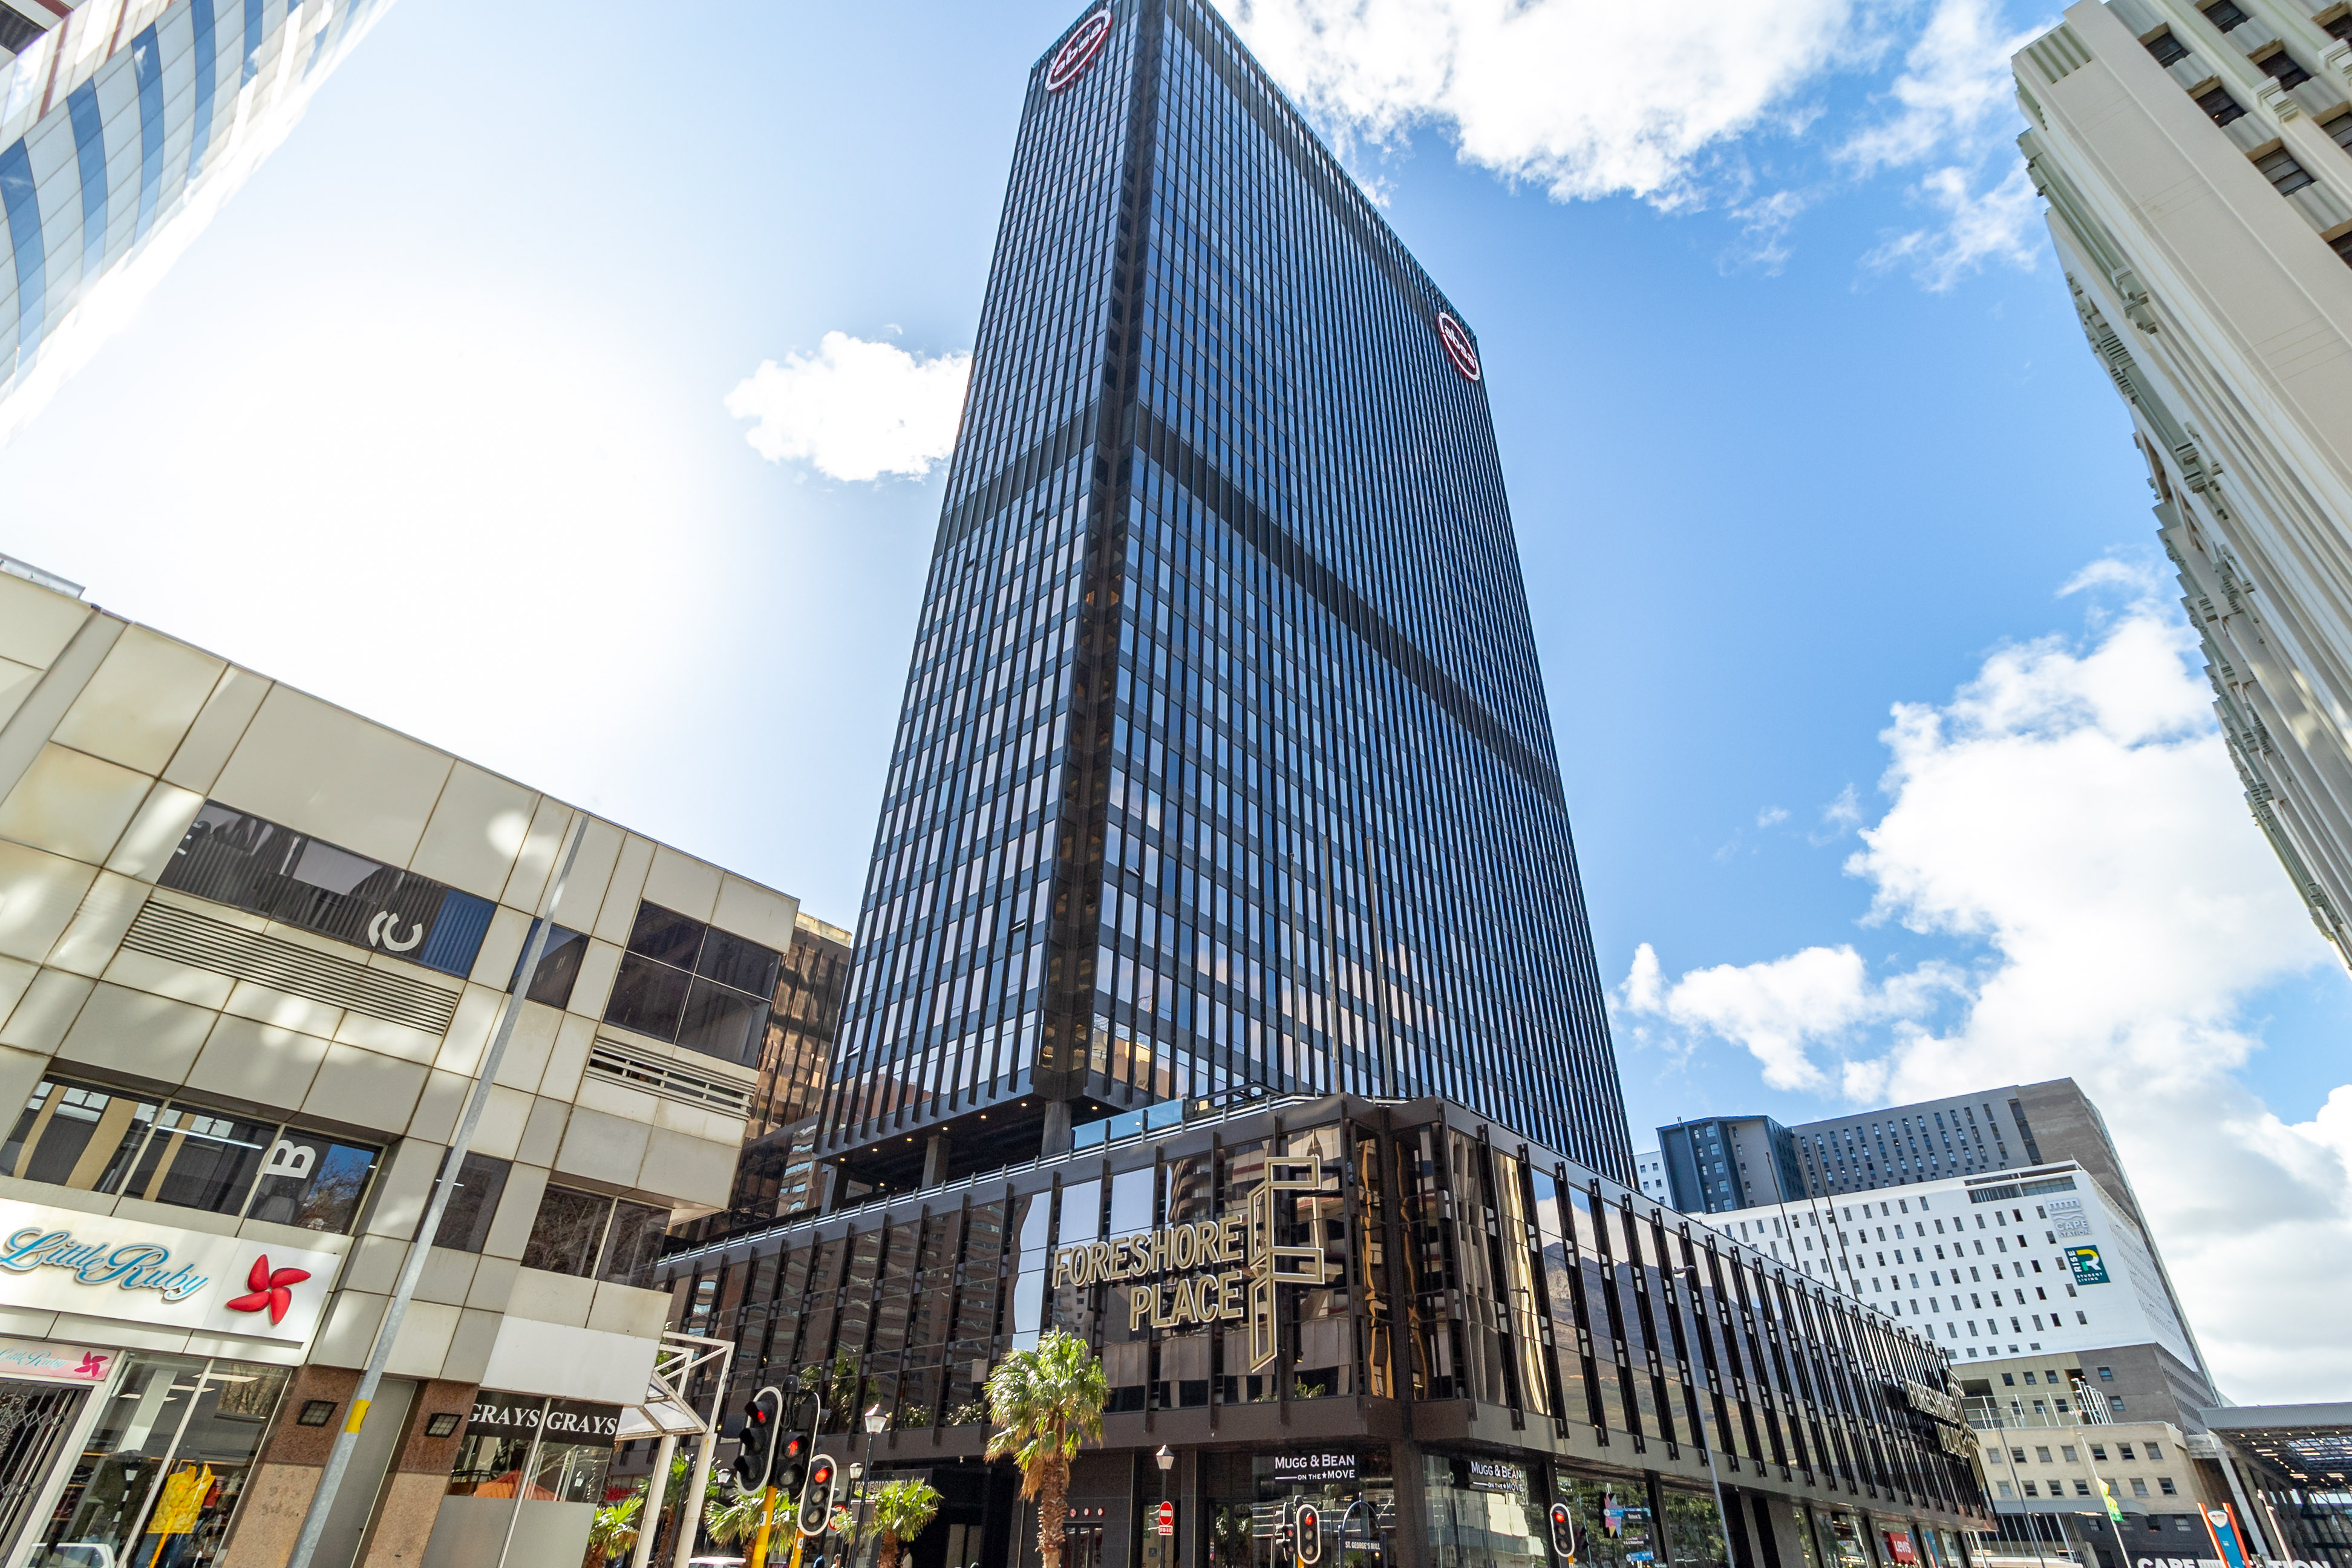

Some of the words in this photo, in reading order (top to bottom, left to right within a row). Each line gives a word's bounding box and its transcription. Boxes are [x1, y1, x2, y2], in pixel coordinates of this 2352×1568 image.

[2056, 1220, 2089, 1231] CAPE
[2059, 1229, 2091, 1238] STATION
[1052, 1214, 1244, 1289] FORESHORE
[2068, 1250, 2082, 1272] RISE
[0, 1227, 105, 1273] Little
[76, 1243, 209, 1301] Ruby
[1129, 1270, 1244, 1331] PLACE
[18, 1350, 68, 1370] Ruby
[468, 1403, 541, 1428] GRAYS
[546, 1411, 618, 1435] GRAYS
[1275, 1456, 1307, 1469] MUGG
[1310, 1454, 1319, 1467] &
[1322, 1454, 1355, 1466] BEAN
[1471, 1461, 1494, 1476] MUGG
[1494, 1465, 1501, 1477] &
[1501, 1465, 1522, 1480] BEAN
[1327, 1469, 1355, 1478] MOVE
[1506, 1481, 1524, 1492] MOVE
